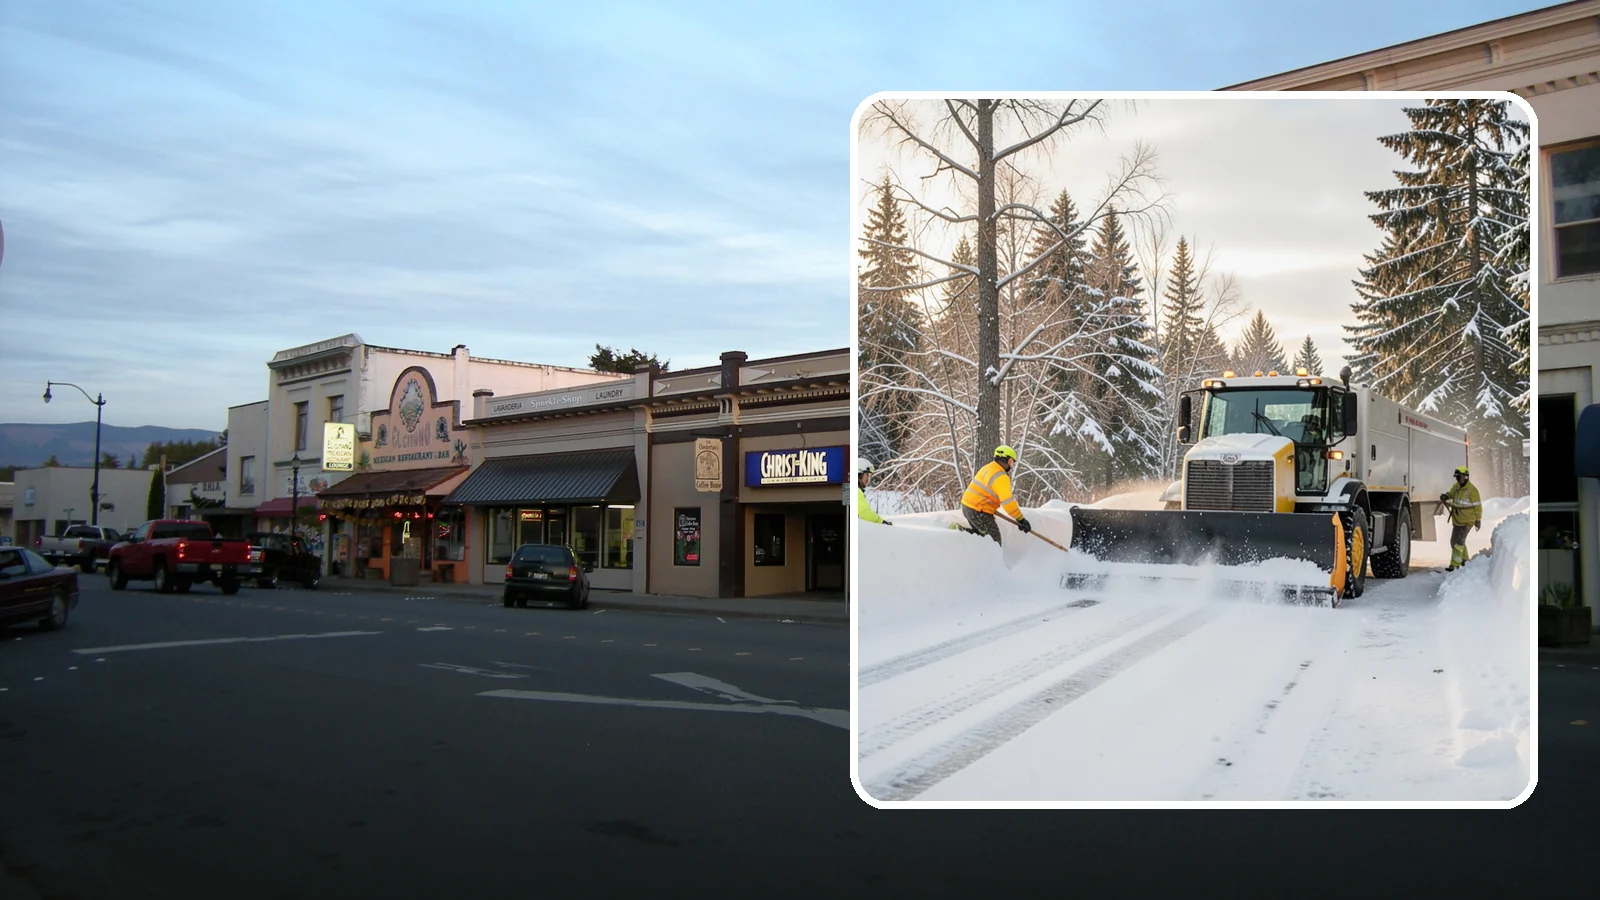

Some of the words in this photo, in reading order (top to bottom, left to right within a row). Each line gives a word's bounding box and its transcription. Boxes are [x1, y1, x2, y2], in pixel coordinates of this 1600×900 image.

[595, 389, 624, 400] LAUNDRY
[530, 397, 562, 409] Sparkle
[562, 394, 583, 405] Shop
[493, 402, 523, 413] LAVANDERIA
[398, 452, 433, 461] RESTAURANT
[438, 450, 450, 459] BAR
[761, 452, 797, 477] CHRIST
[799, 450, 827, 476] KING
[696, 480, 709, 489] Coffee
